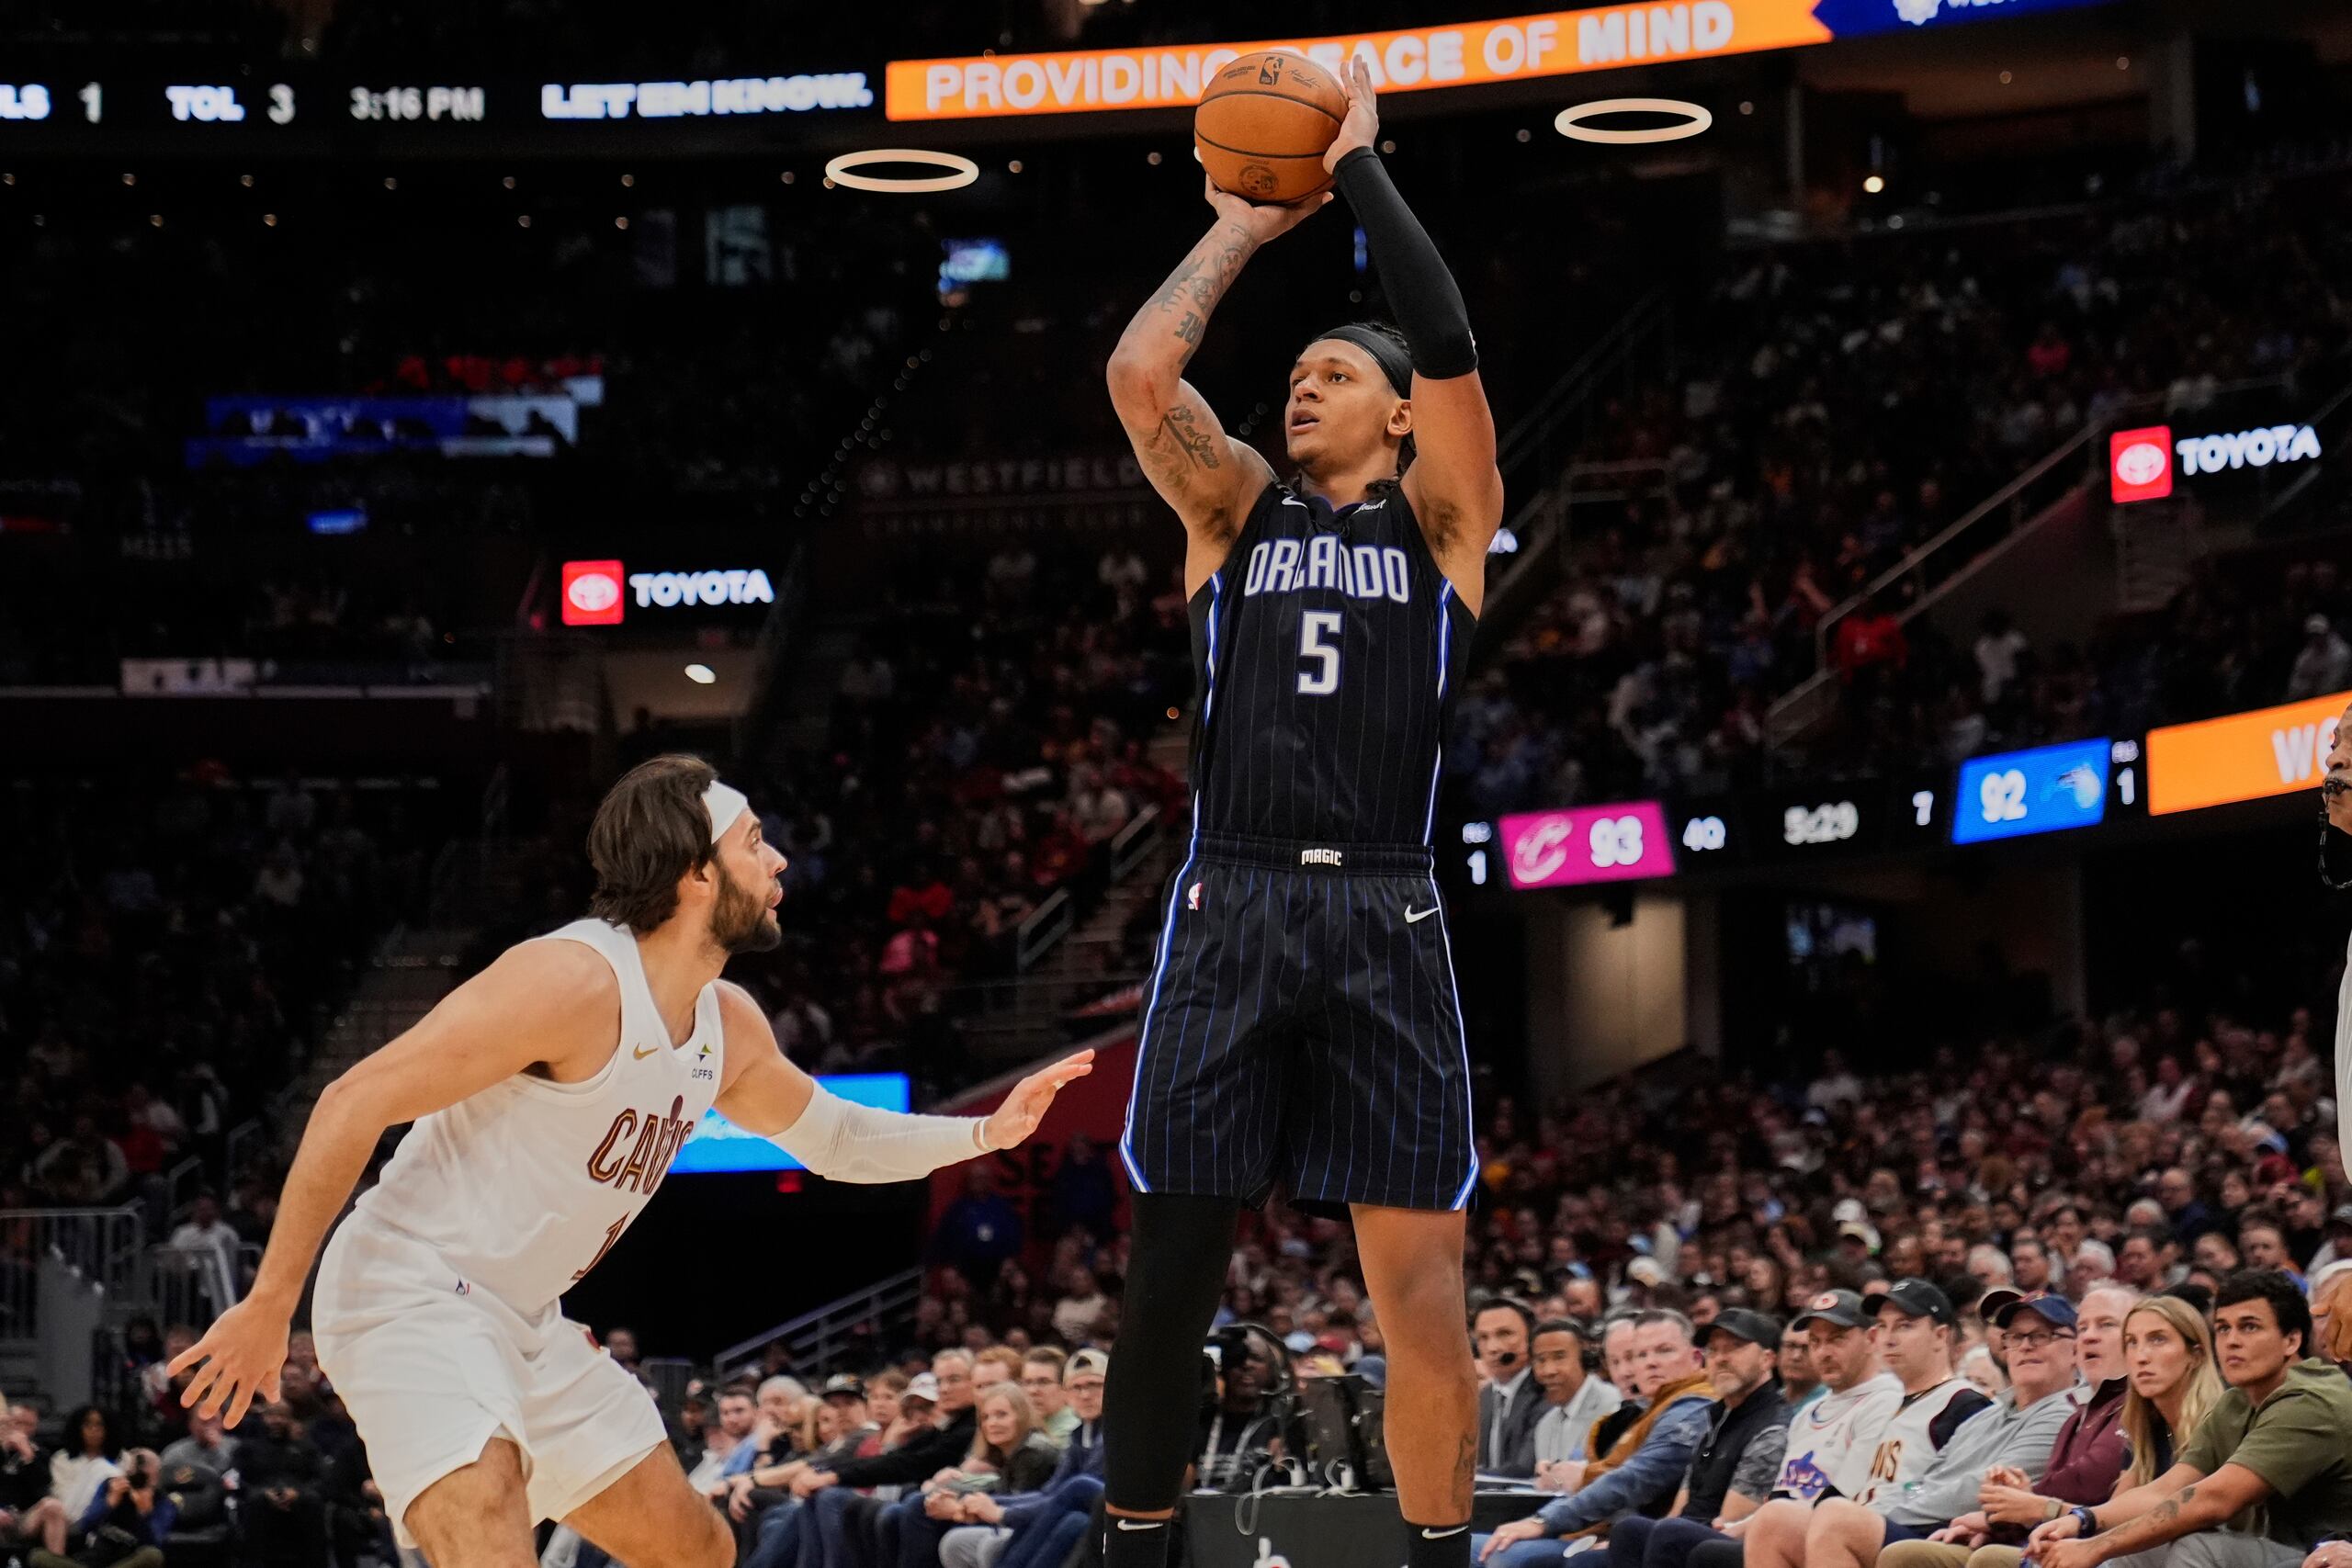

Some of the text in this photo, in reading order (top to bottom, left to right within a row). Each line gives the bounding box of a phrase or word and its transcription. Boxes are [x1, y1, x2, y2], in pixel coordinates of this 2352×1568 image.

[1268, 31, 1465, 93] EACE
[1483, 19, 1558, 75] OF
[1577, 1, 1734, 64] MIND
[80, 82, 102, 124] 1
[165, 83, 296, 124] TOL 3
[427, 86, 486, 120] PM
[541, 84, 636, 118] LET
[2175, 423, 2323, 476] TOYOTA
[628, 569, 775, 608] TOYOTA
[1244, 536, 1409, 604] ORLANDO
[1297, 611, 1342, 694] 5
[1980, 769, 2029, 824] 92
[2116, 767, 2135, 805] 1
[1912, 790, 1934, 826] 7
[1301, 849, 1342, 866] MAGIC
[1589, 815, 1644, 867] 93
[1466, 849, 1487, 886] 1
